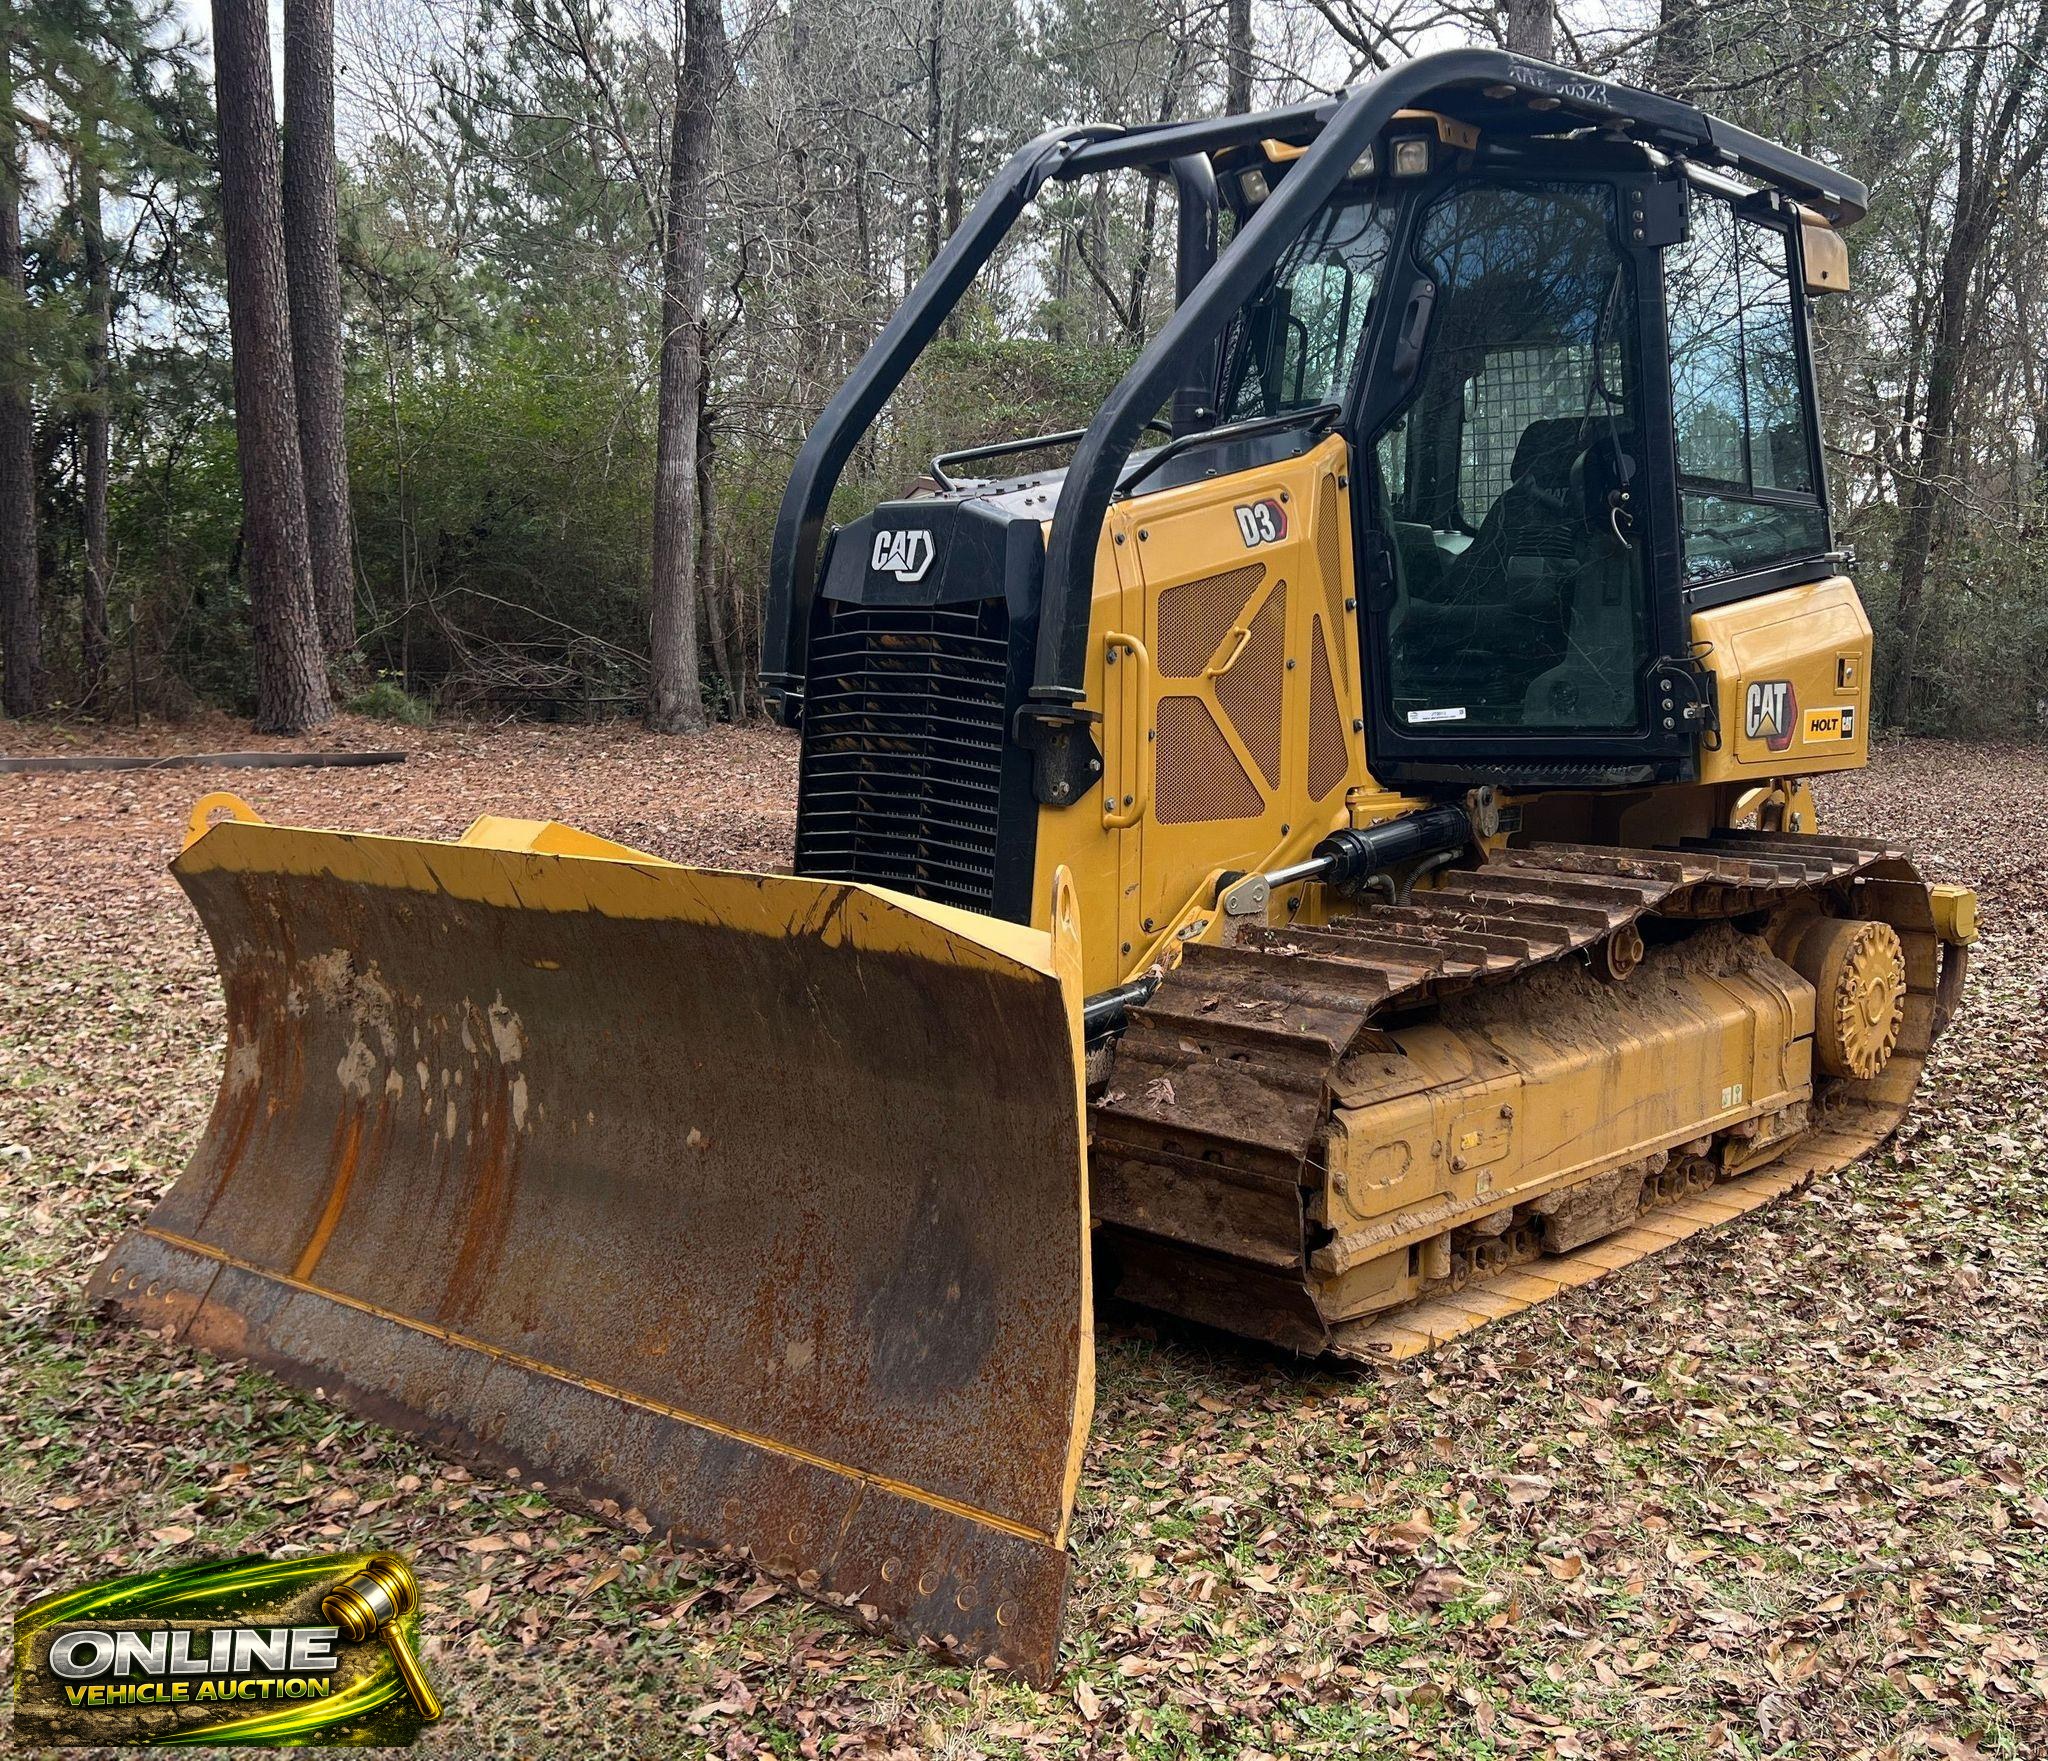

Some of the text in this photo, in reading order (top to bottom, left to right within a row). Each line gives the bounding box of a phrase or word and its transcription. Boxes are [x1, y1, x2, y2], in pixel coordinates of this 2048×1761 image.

[1235, 503, 1276, 546] D3
[871, 530, 924, 572] CAT
[1746, 683, 1787, 738] CAT
[1811, 719, 1839, 732] HOLT
